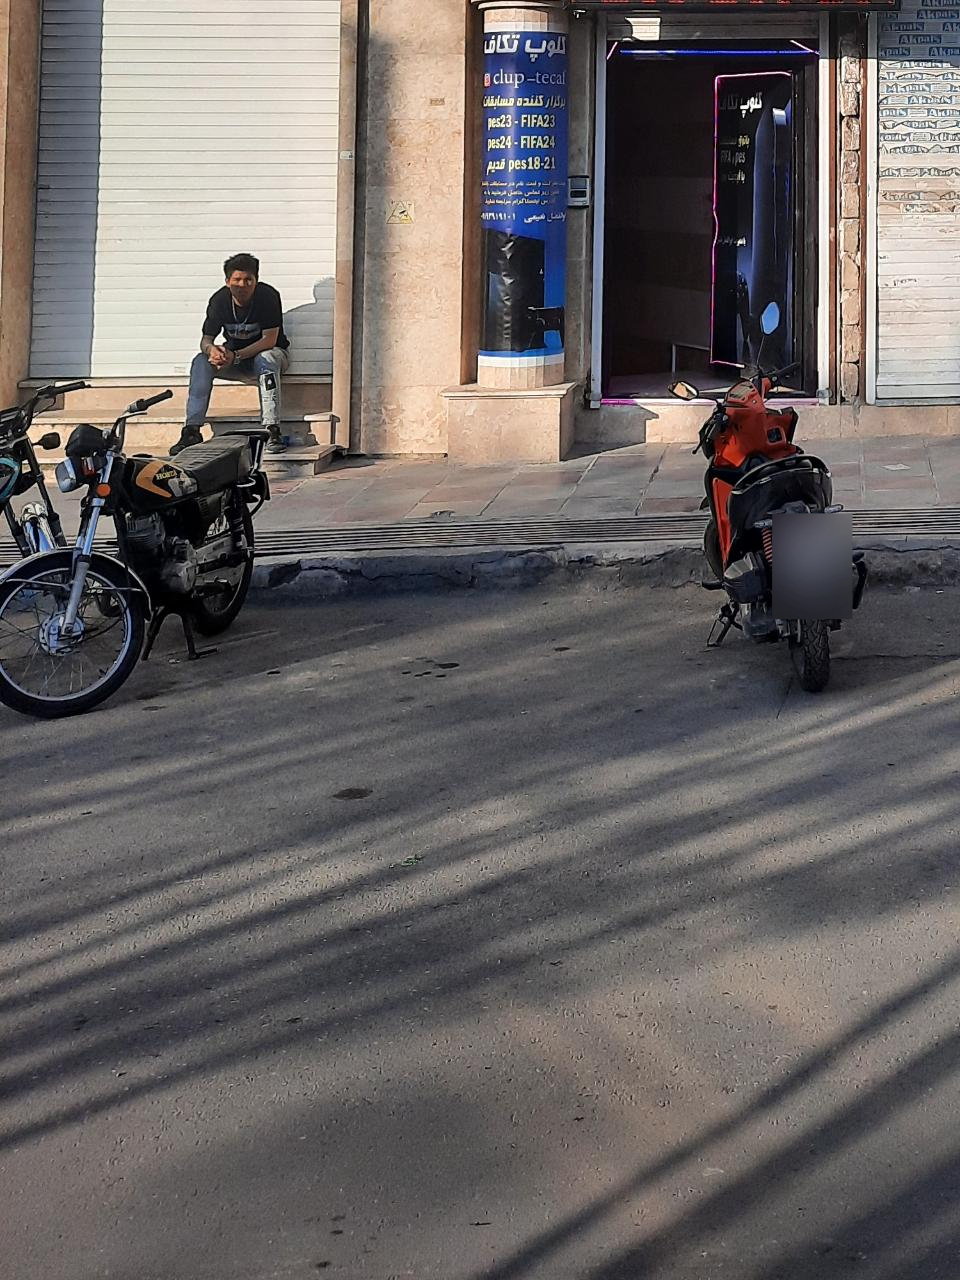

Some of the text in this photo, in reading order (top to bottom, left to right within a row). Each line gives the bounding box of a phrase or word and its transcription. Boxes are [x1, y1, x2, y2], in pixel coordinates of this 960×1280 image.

[493, 69, 524, 88] clup
[521, 114, 555, 127] FIFA23
[520, 135, 555, 149] FIFA24
